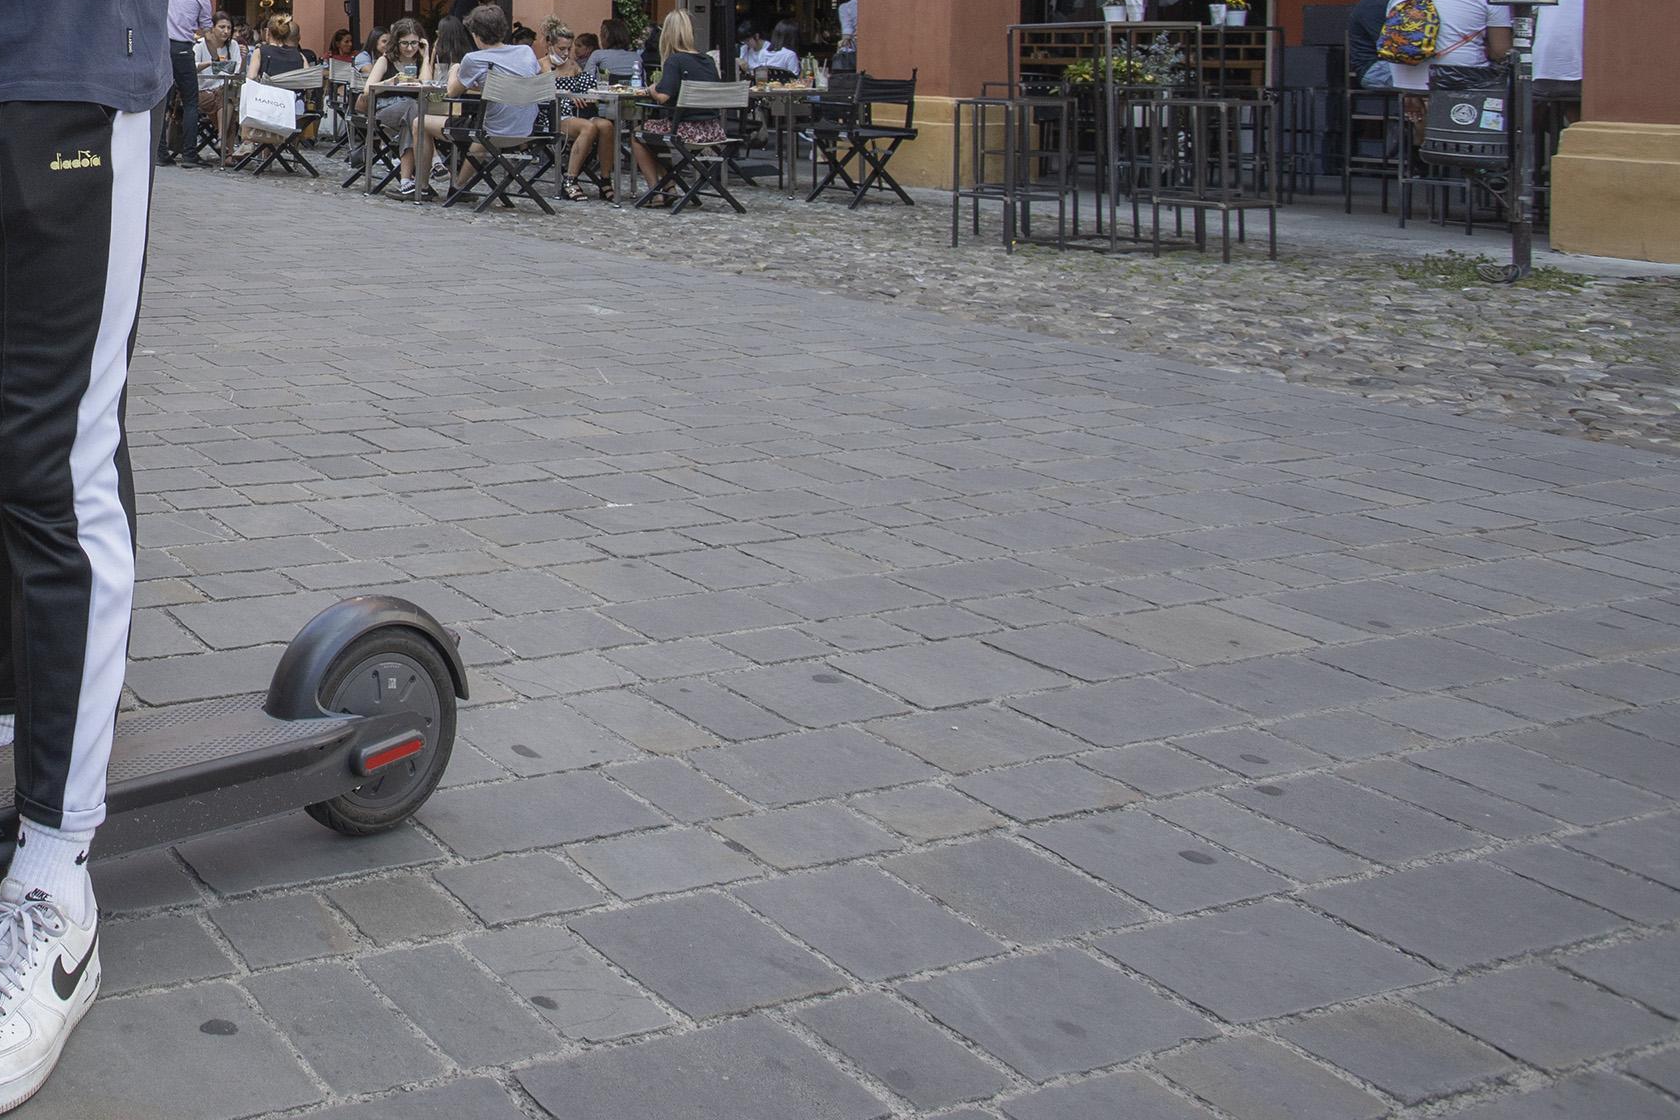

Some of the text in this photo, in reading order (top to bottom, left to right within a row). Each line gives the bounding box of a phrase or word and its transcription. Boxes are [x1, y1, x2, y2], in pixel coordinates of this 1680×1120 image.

[255, 97, 286, 109] MANGO
[49, 150, 101, 171] diadora
[31, 888, 50, 900] NIKE
